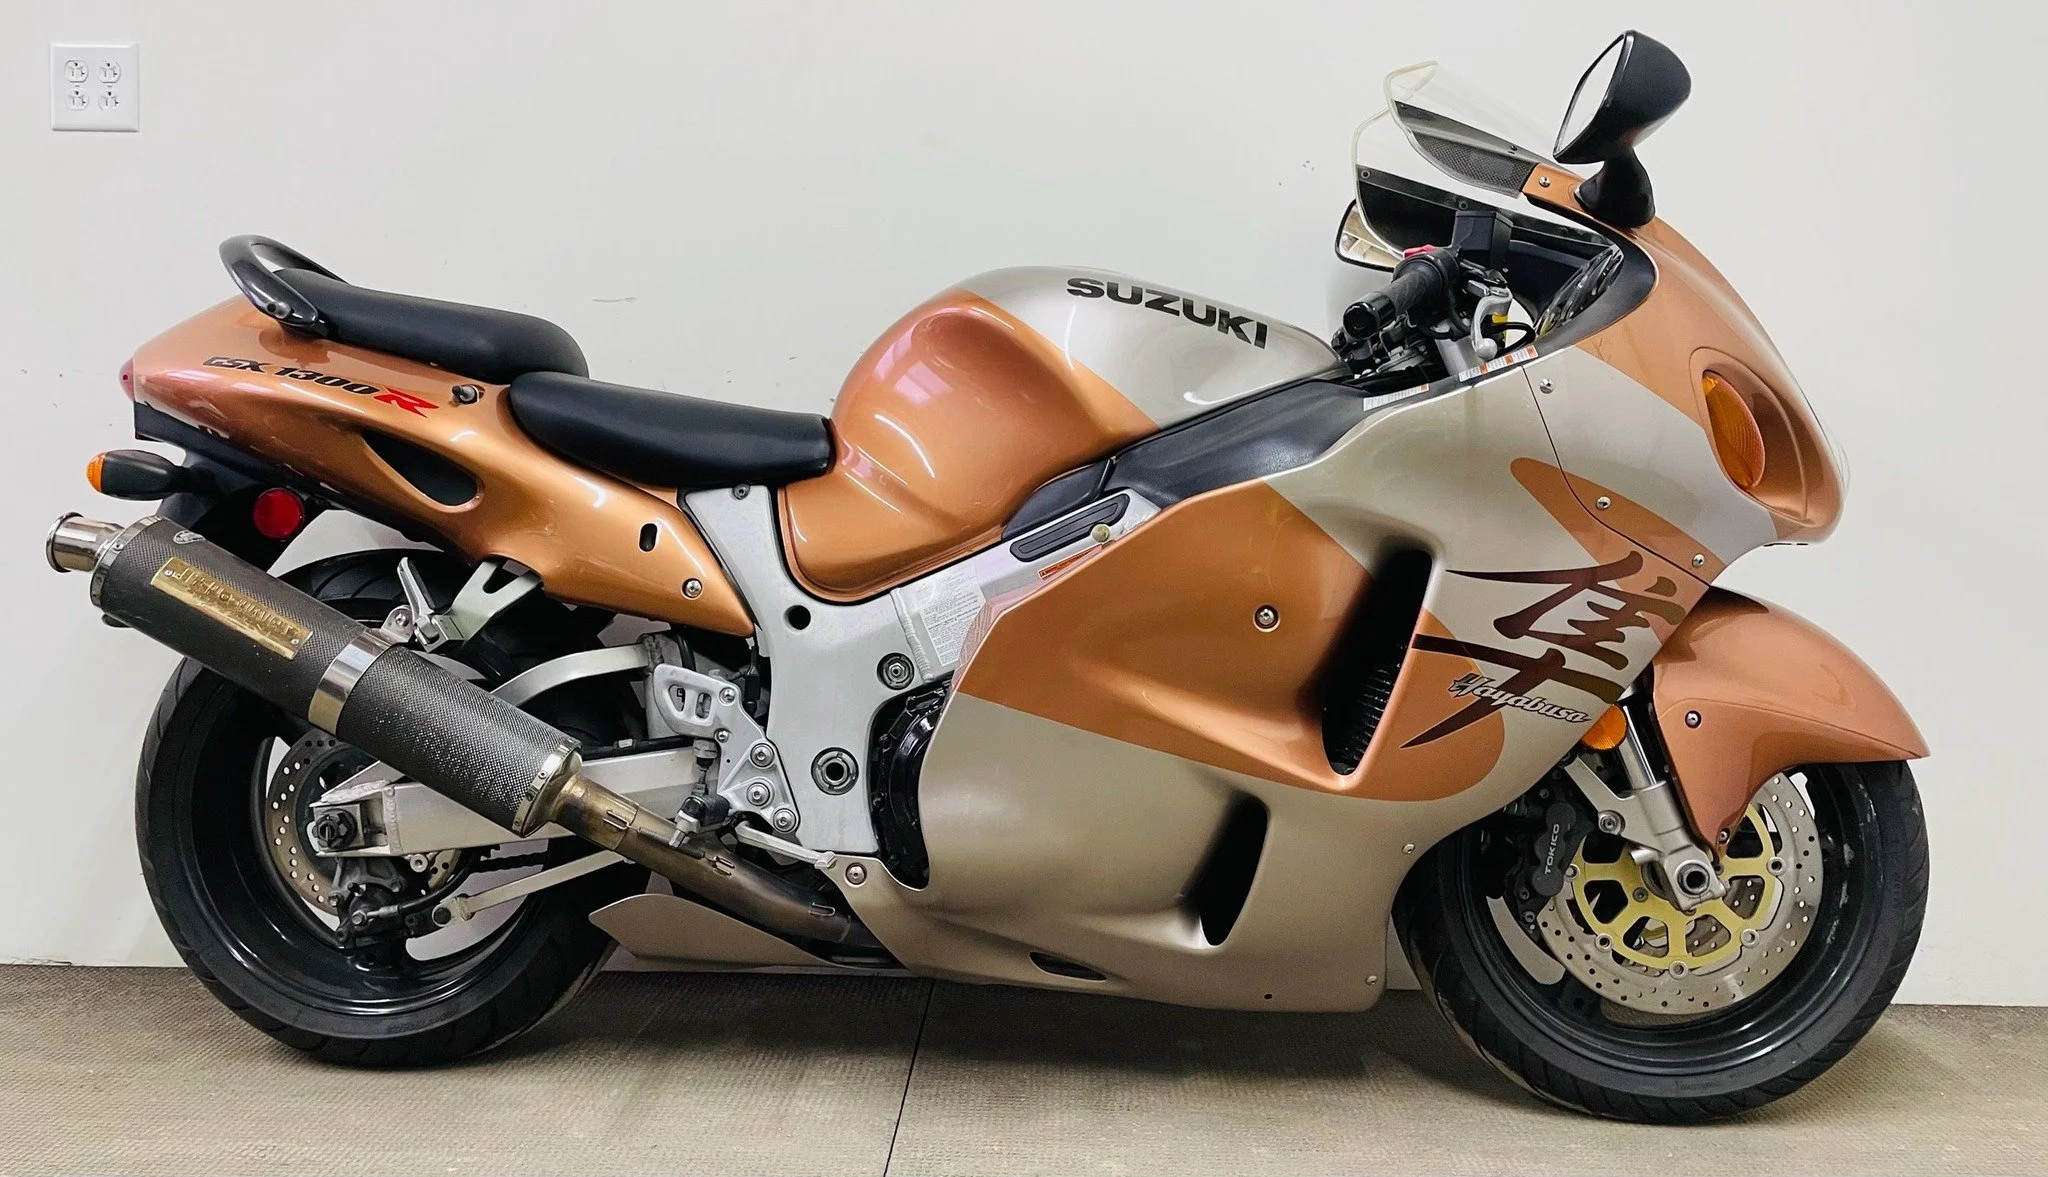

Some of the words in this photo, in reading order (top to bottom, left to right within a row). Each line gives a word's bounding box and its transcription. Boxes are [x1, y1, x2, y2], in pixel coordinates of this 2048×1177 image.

[1066, 277, 1268, 350] SUZUKI
[202, 356, 272, 373] GSX
[1399, 550, 1687, 749] 隼
[1447, 672, 1593, 724] Hayabusa
[1544, 823, 1560, 875] TOKICO
